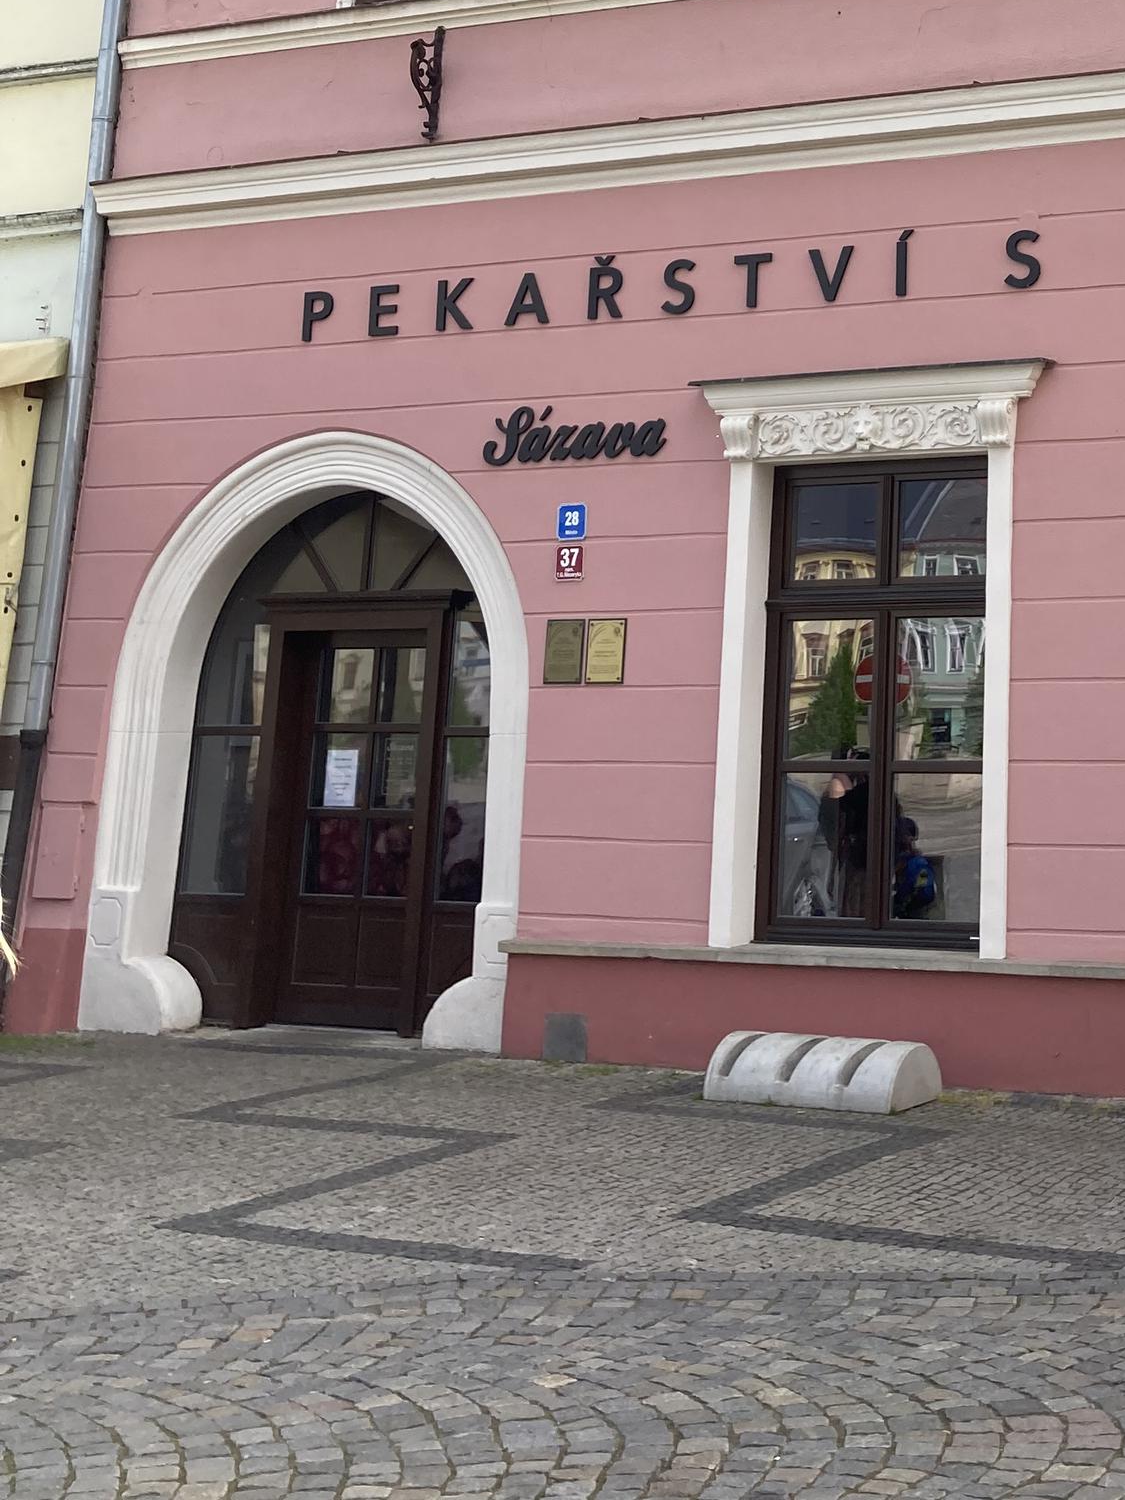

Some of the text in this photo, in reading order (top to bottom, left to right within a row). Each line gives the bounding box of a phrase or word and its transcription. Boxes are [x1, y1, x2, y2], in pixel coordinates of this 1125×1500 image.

[301, 229, 915, 342] PEKAŘSTVÍ
[1003, 231, 1042, 290] S
[482, 404, 667, 467] Sázava
[564, 511, 580, 527] 28
[560, 548, 580, 568] 37
